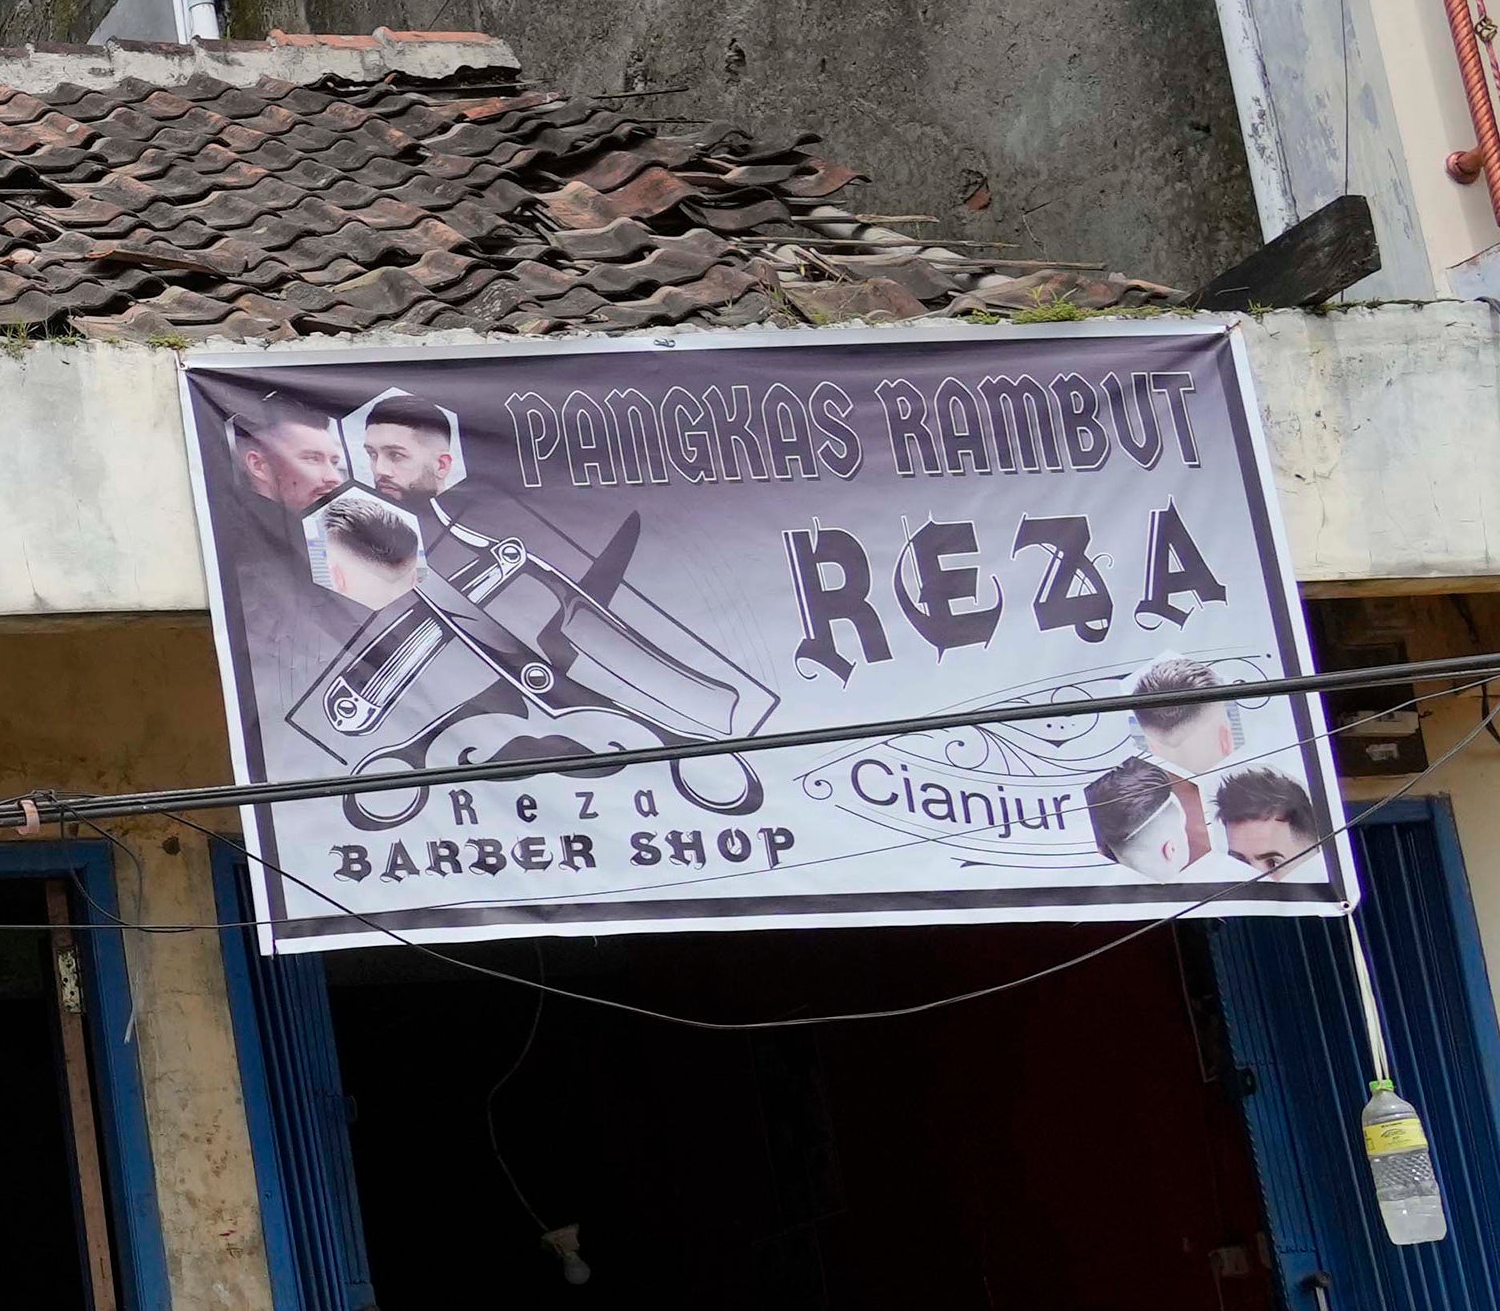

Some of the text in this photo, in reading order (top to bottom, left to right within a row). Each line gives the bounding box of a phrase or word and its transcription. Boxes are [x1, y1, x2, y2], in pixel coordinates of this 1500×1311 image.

[505, 372, 1201, 488] PANGKAS RAMBUT
[782, 494, 1228, 688] REZA
[850, 758, 1071, 839] Cianjur
[329, 826, 795, 884] BARBER SHOP
